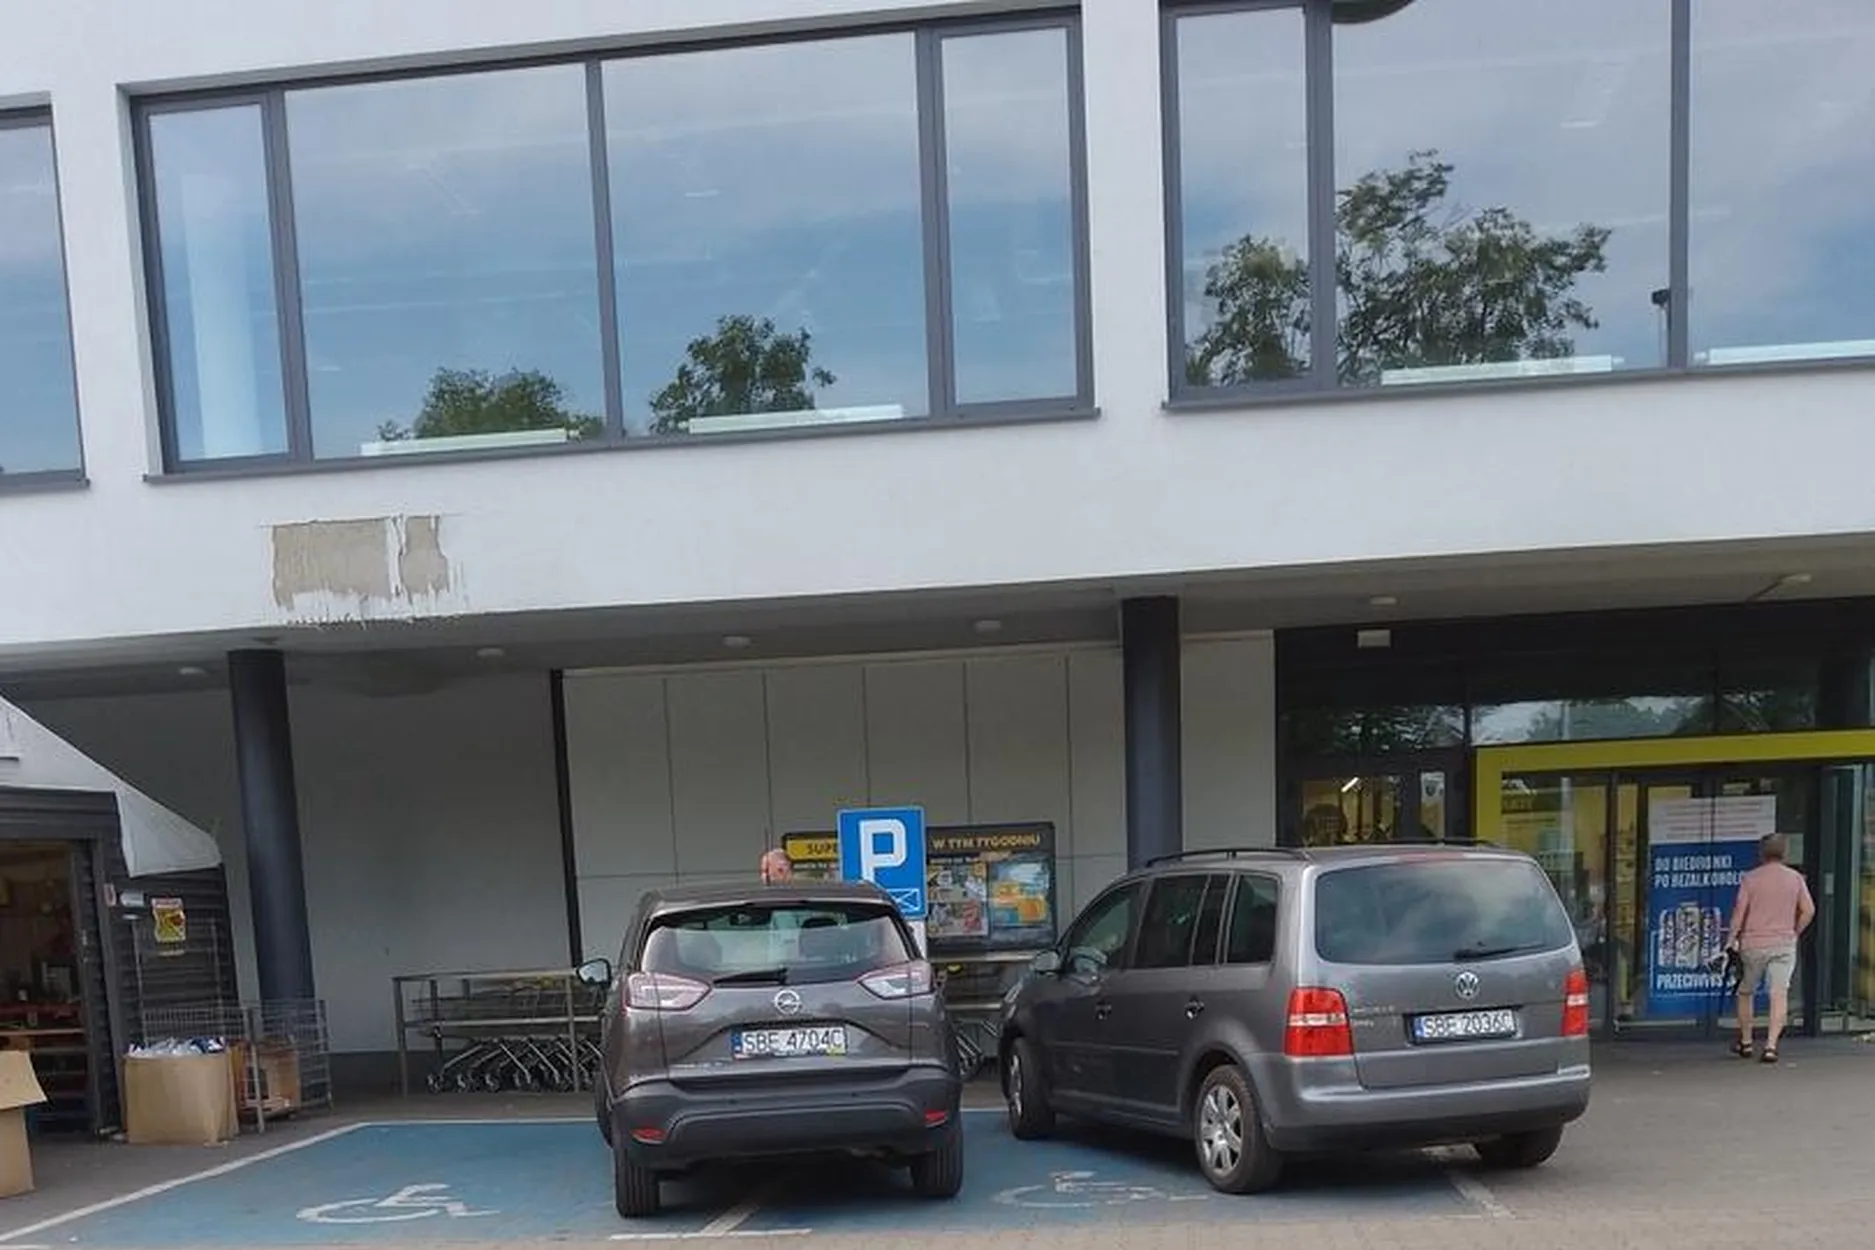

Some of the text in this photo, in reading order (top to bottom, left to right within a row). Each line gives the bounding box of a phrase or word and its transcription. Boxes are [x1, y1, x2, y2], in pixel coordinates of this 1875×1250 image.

[859, 819, 906, 881] P
[931, 838, 945, 849] W
[976, 832, 1040, 851] TYGODNIU
[1424, 1015, 1457, 1037] SBE
[742, 1030, 781, 1053] SBE
